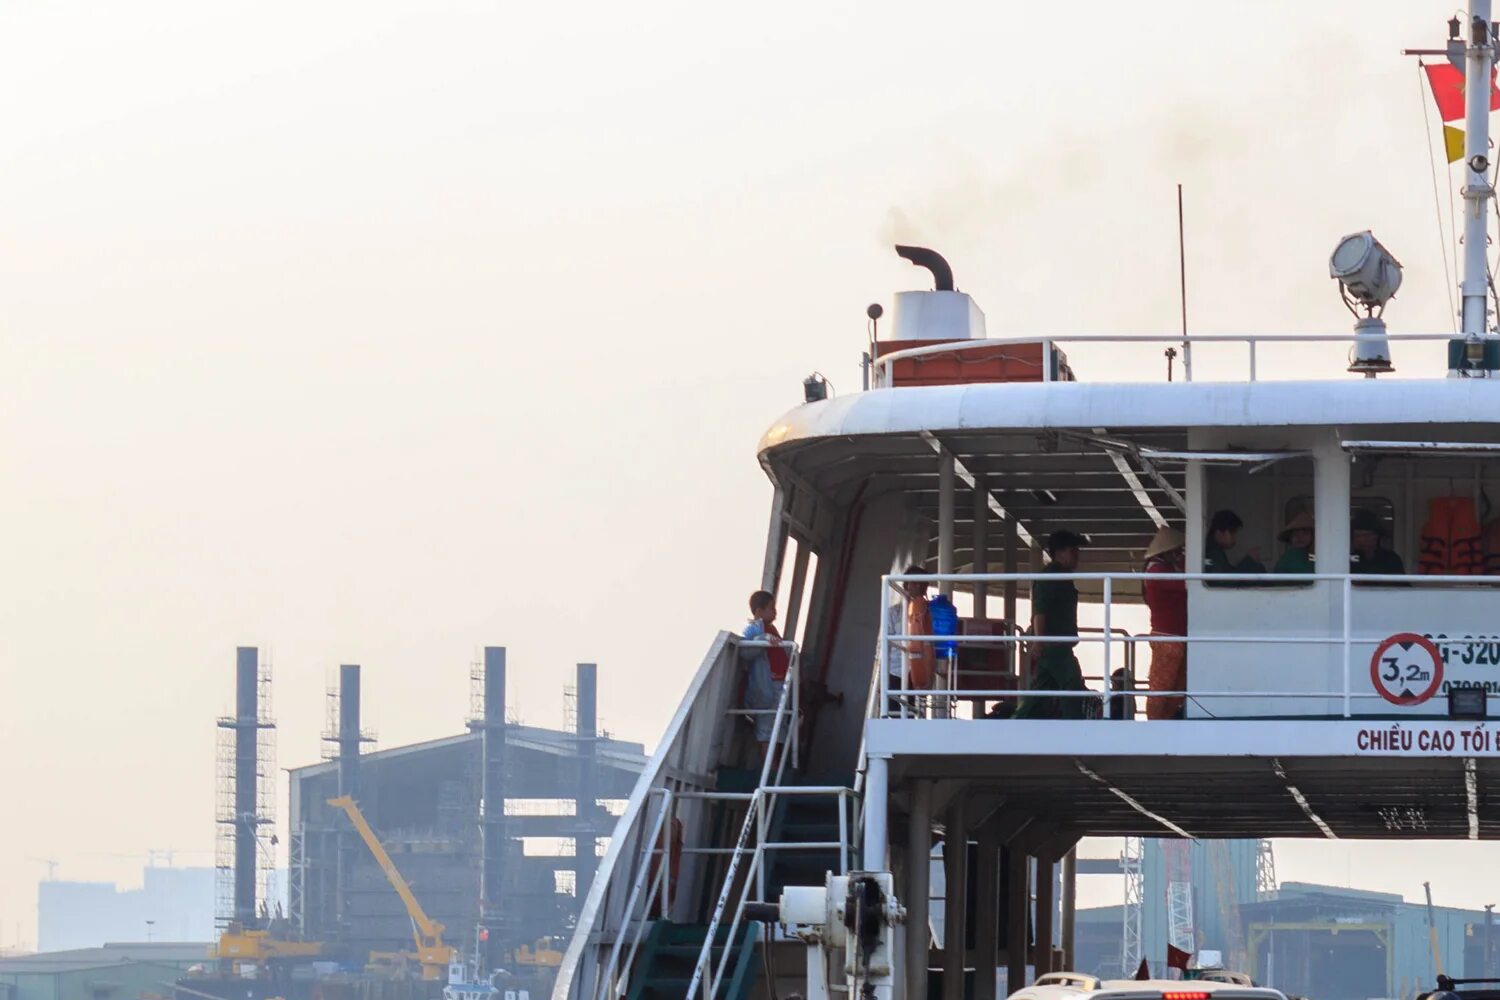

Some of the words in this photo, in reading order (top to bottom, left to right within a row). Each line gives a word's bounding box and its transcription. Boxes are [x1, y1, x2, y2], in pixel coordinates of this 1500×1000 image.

[1382, 657, 1430, 686] 3,2m
[1357, 723, 1412, 751] CHIỀU
[1418, 730, 1455, 752] CAO
[1461, 723, 1490, 752] TỐI
